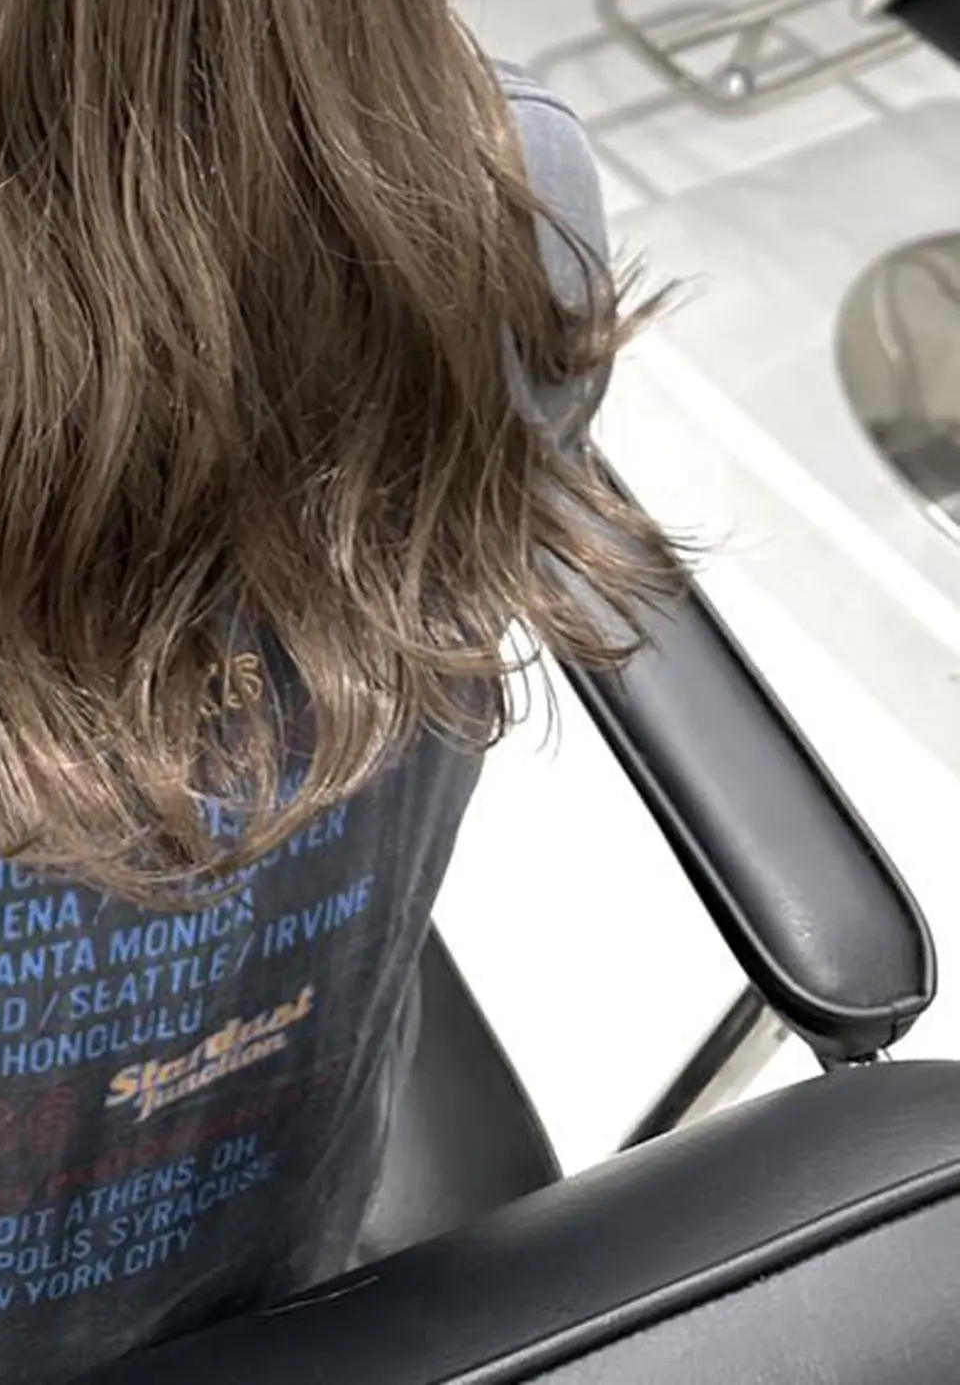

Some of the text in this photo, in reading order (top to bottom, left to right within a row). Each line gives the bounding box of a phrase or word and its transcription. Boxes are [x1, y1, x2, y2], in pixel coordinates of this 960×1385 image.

[69, 943, 231, 1020] SEATTLE
[263, 874, 375, 957] IRVINE
[109, 887, 254, 965] MONICA
[0, 997, 203, 1077] HONOLULU
[211, 1132, 258, 1172] OH
[105, 1151, 280, 1247] SYRACUSE
[25, 1253, 113, 1305] YORK
[123, 1220, 196, 1276] CITY
